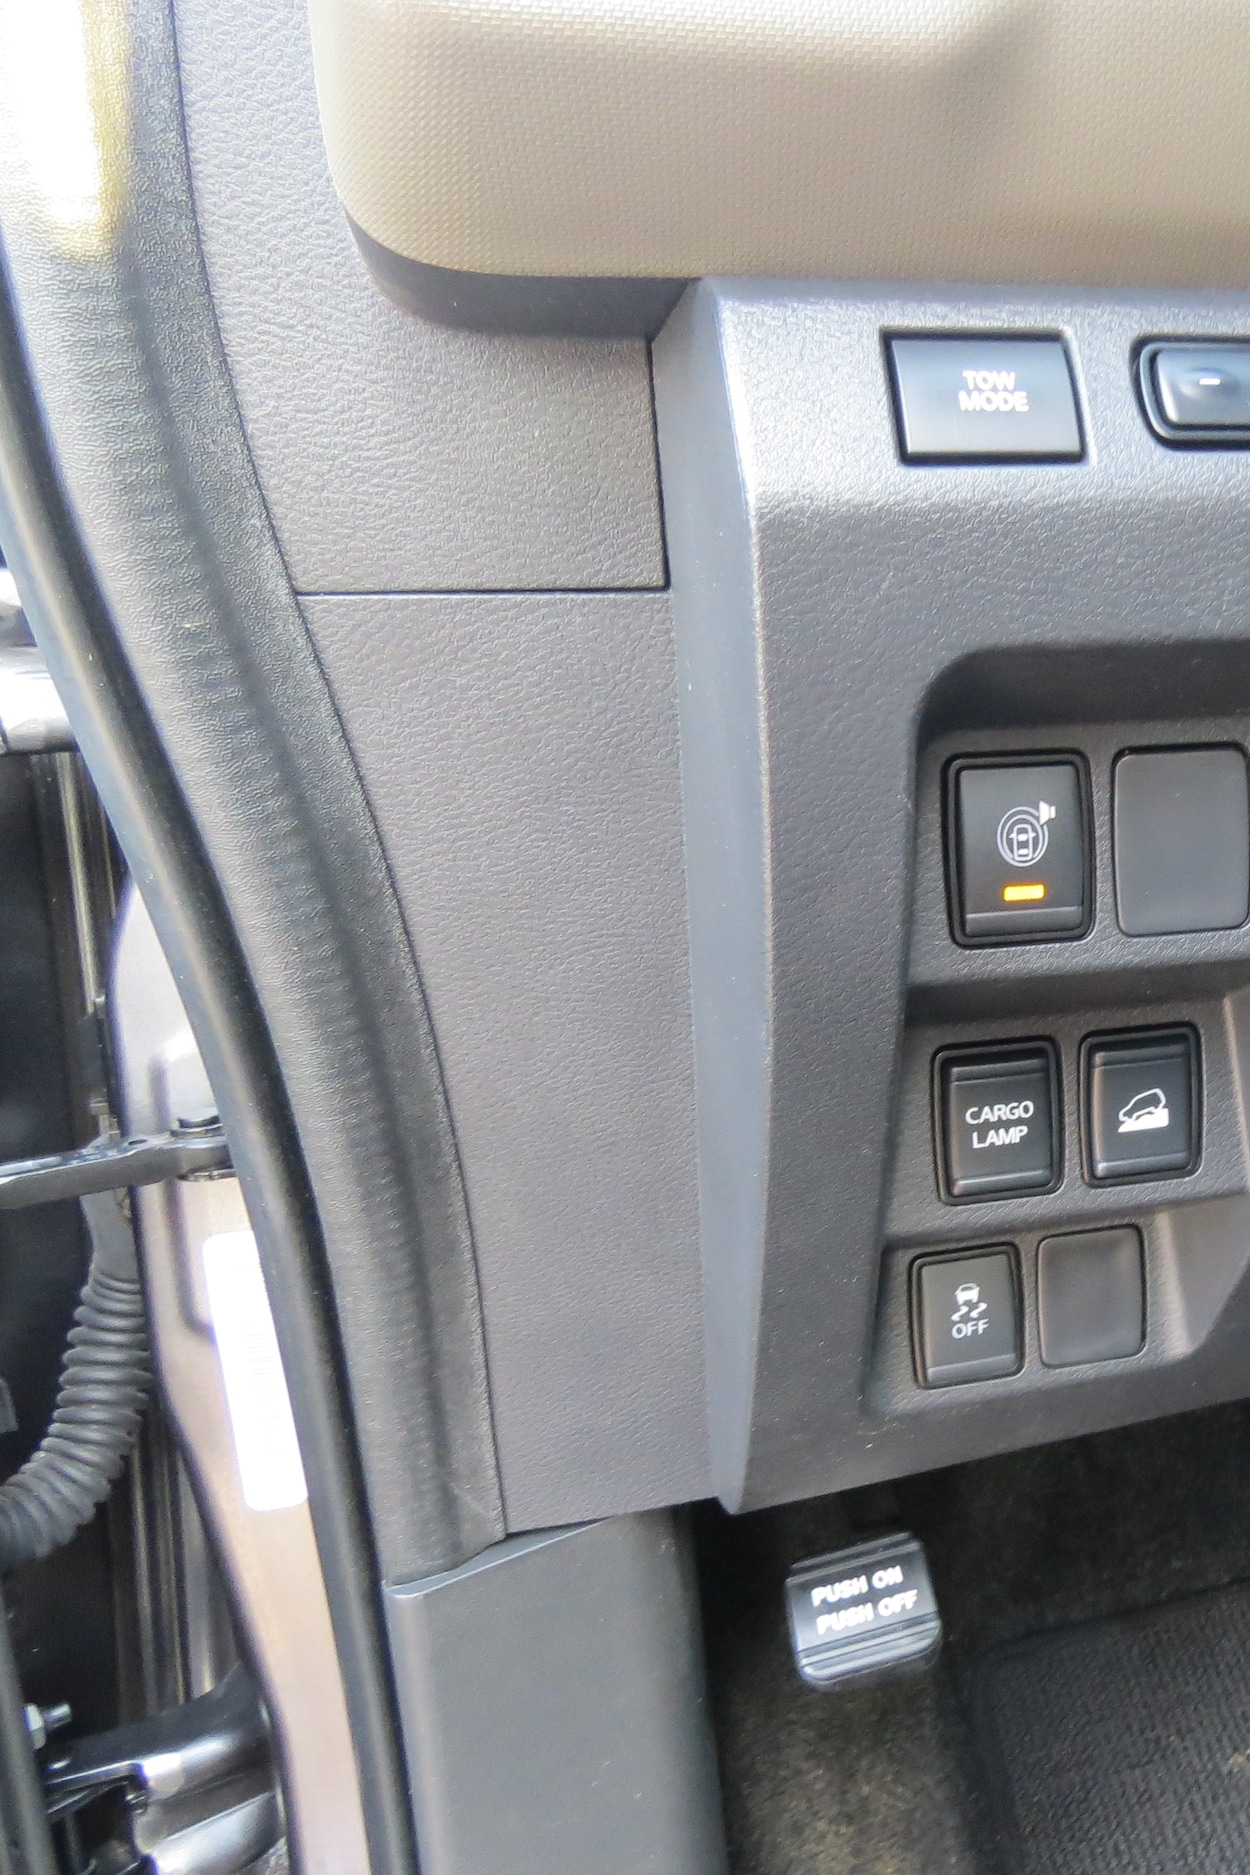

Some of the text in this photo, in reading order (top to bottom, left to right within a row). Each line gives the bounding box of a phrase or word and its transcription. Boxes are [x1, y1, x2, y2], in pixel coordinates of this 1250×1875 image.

[962, 370, 1016, 391] TOW
[958, 390, 1029, 412] MODE
[965, 1100, 1034, 1125] CARGO
[972, 1125, 1028, 1149] LAMP
[951, 1319, 989, 1339] OFF
[811, 1565, 904, 1607] PUSH ON
[816, 1589, 918, 1635] PUSH OFF
